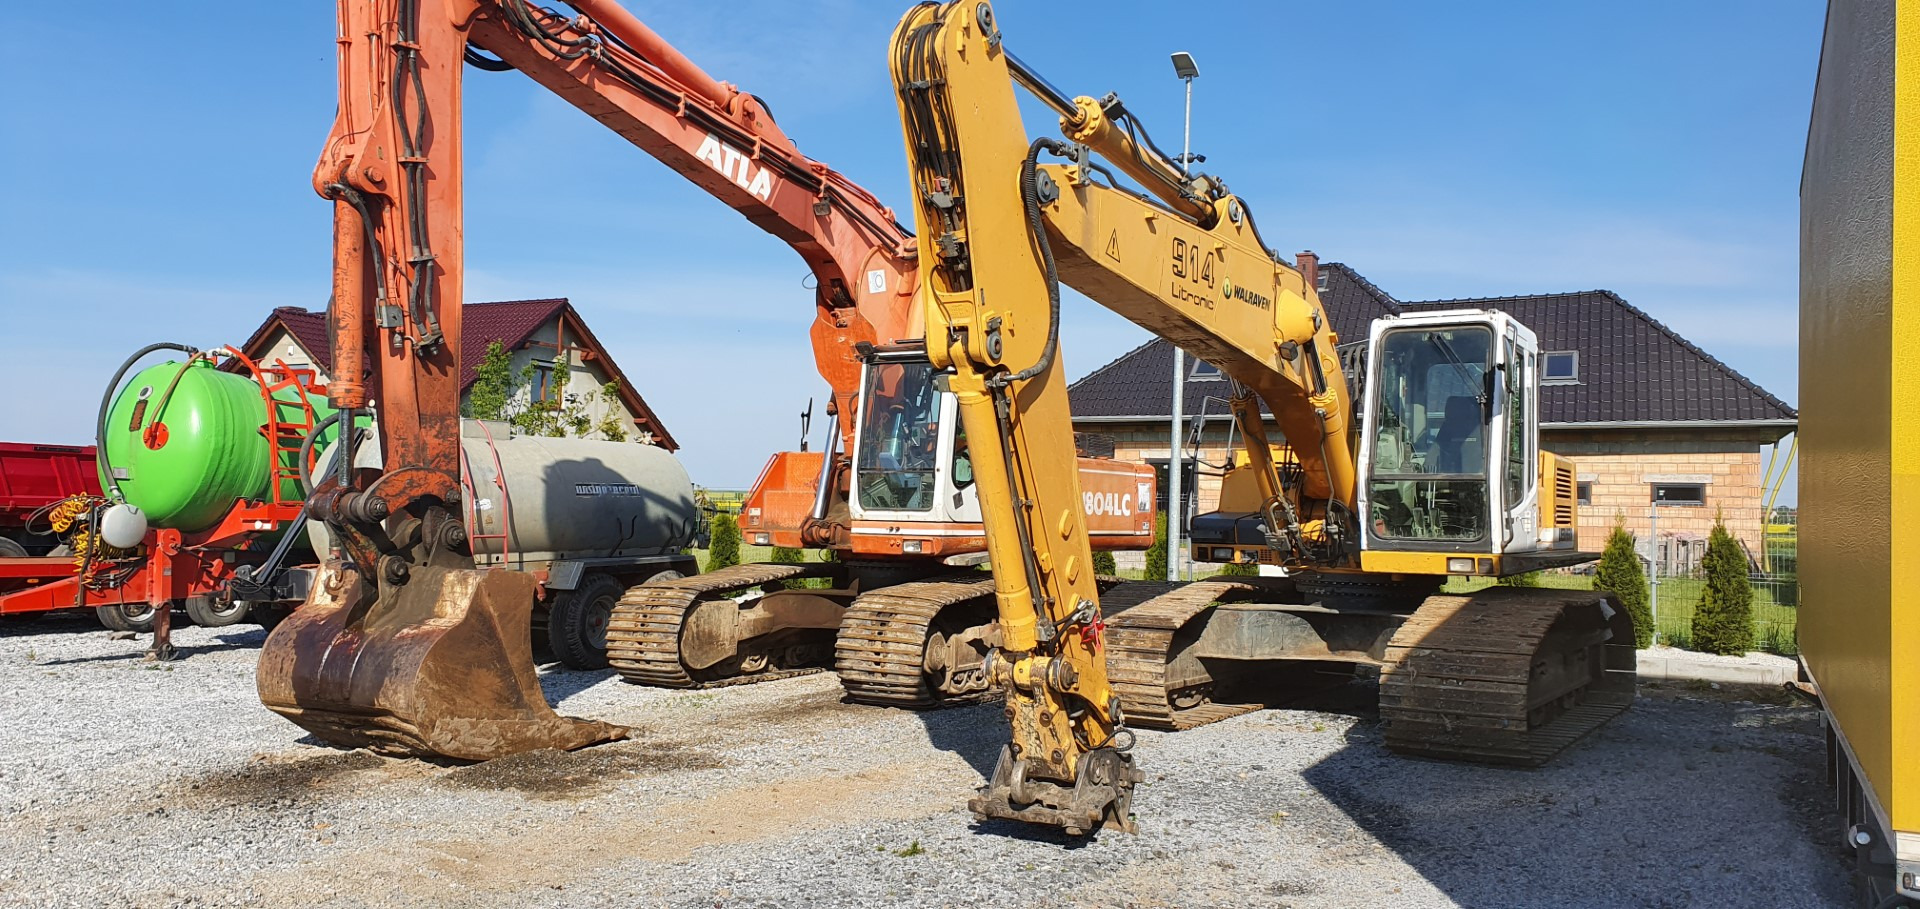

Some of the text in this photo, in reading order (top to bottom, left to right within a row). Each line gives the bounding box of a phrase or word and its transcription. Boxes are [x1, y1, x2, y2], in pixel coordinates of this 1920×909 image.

[1172, 237, 1215, 290] 914
[1171, 281, 1214, 311] Litronic
[1233, 284, 1271, 312] WALRAVEN
